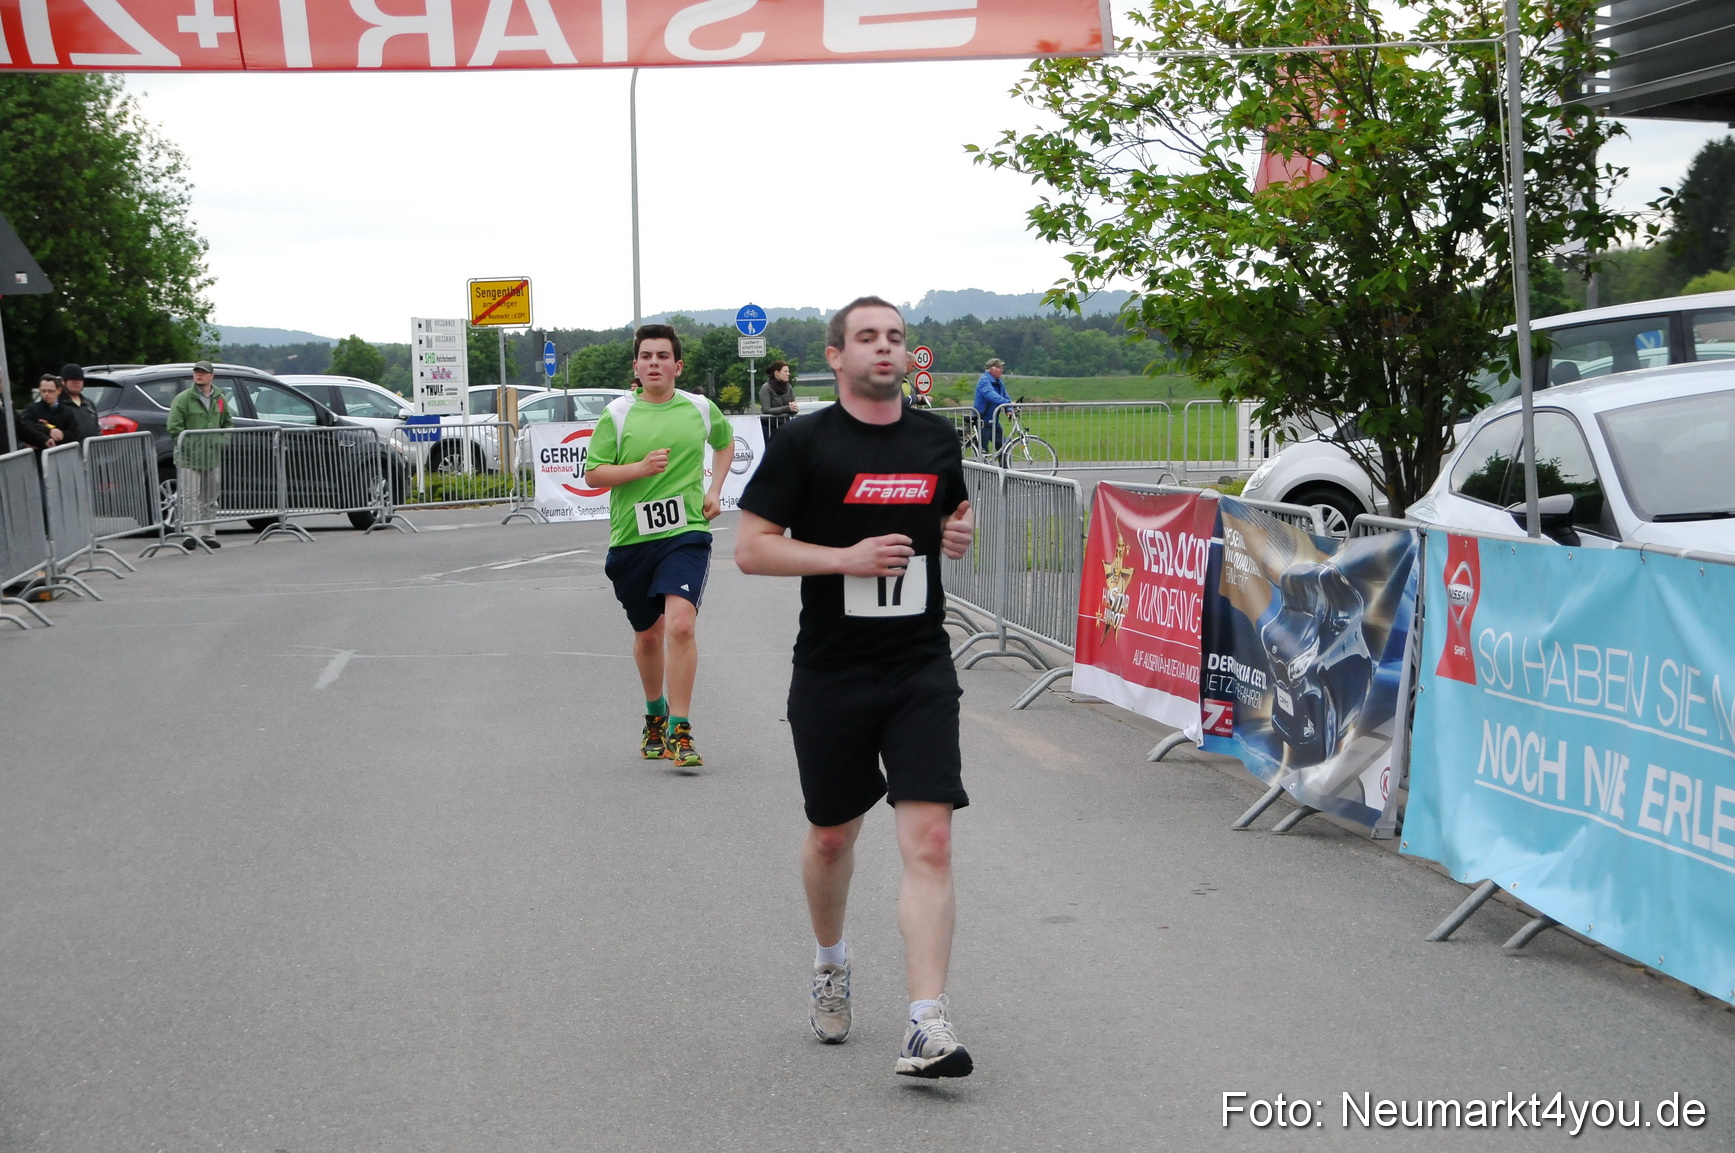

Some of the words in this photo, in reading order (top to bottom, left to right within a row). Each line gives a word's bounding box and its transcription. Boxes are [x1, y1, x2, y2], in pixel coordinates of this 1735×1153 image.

[475, 286, 525, 301] Sengenthal
[482, 301, 494, 309] am
[917, 353, 929, 364] 60
[426, 384, 444, 397] THULE
[541, 464, 574, 473] Autohaus
[854, 479, 930, 499] Franek
[642, 499, 680, 530] 130
[1447, 588, 1472, 602] NISSAN
[1478, 627, 1514, 690] SO
[1521, 636, 1650, 719] HABEN
[1656, 658, 1708, 737] SIE
[1202, 703, 1226, 731] 7
[1476, 718, 1568, 801] NOCH
[1583, 745, 1631, 821] NIE
